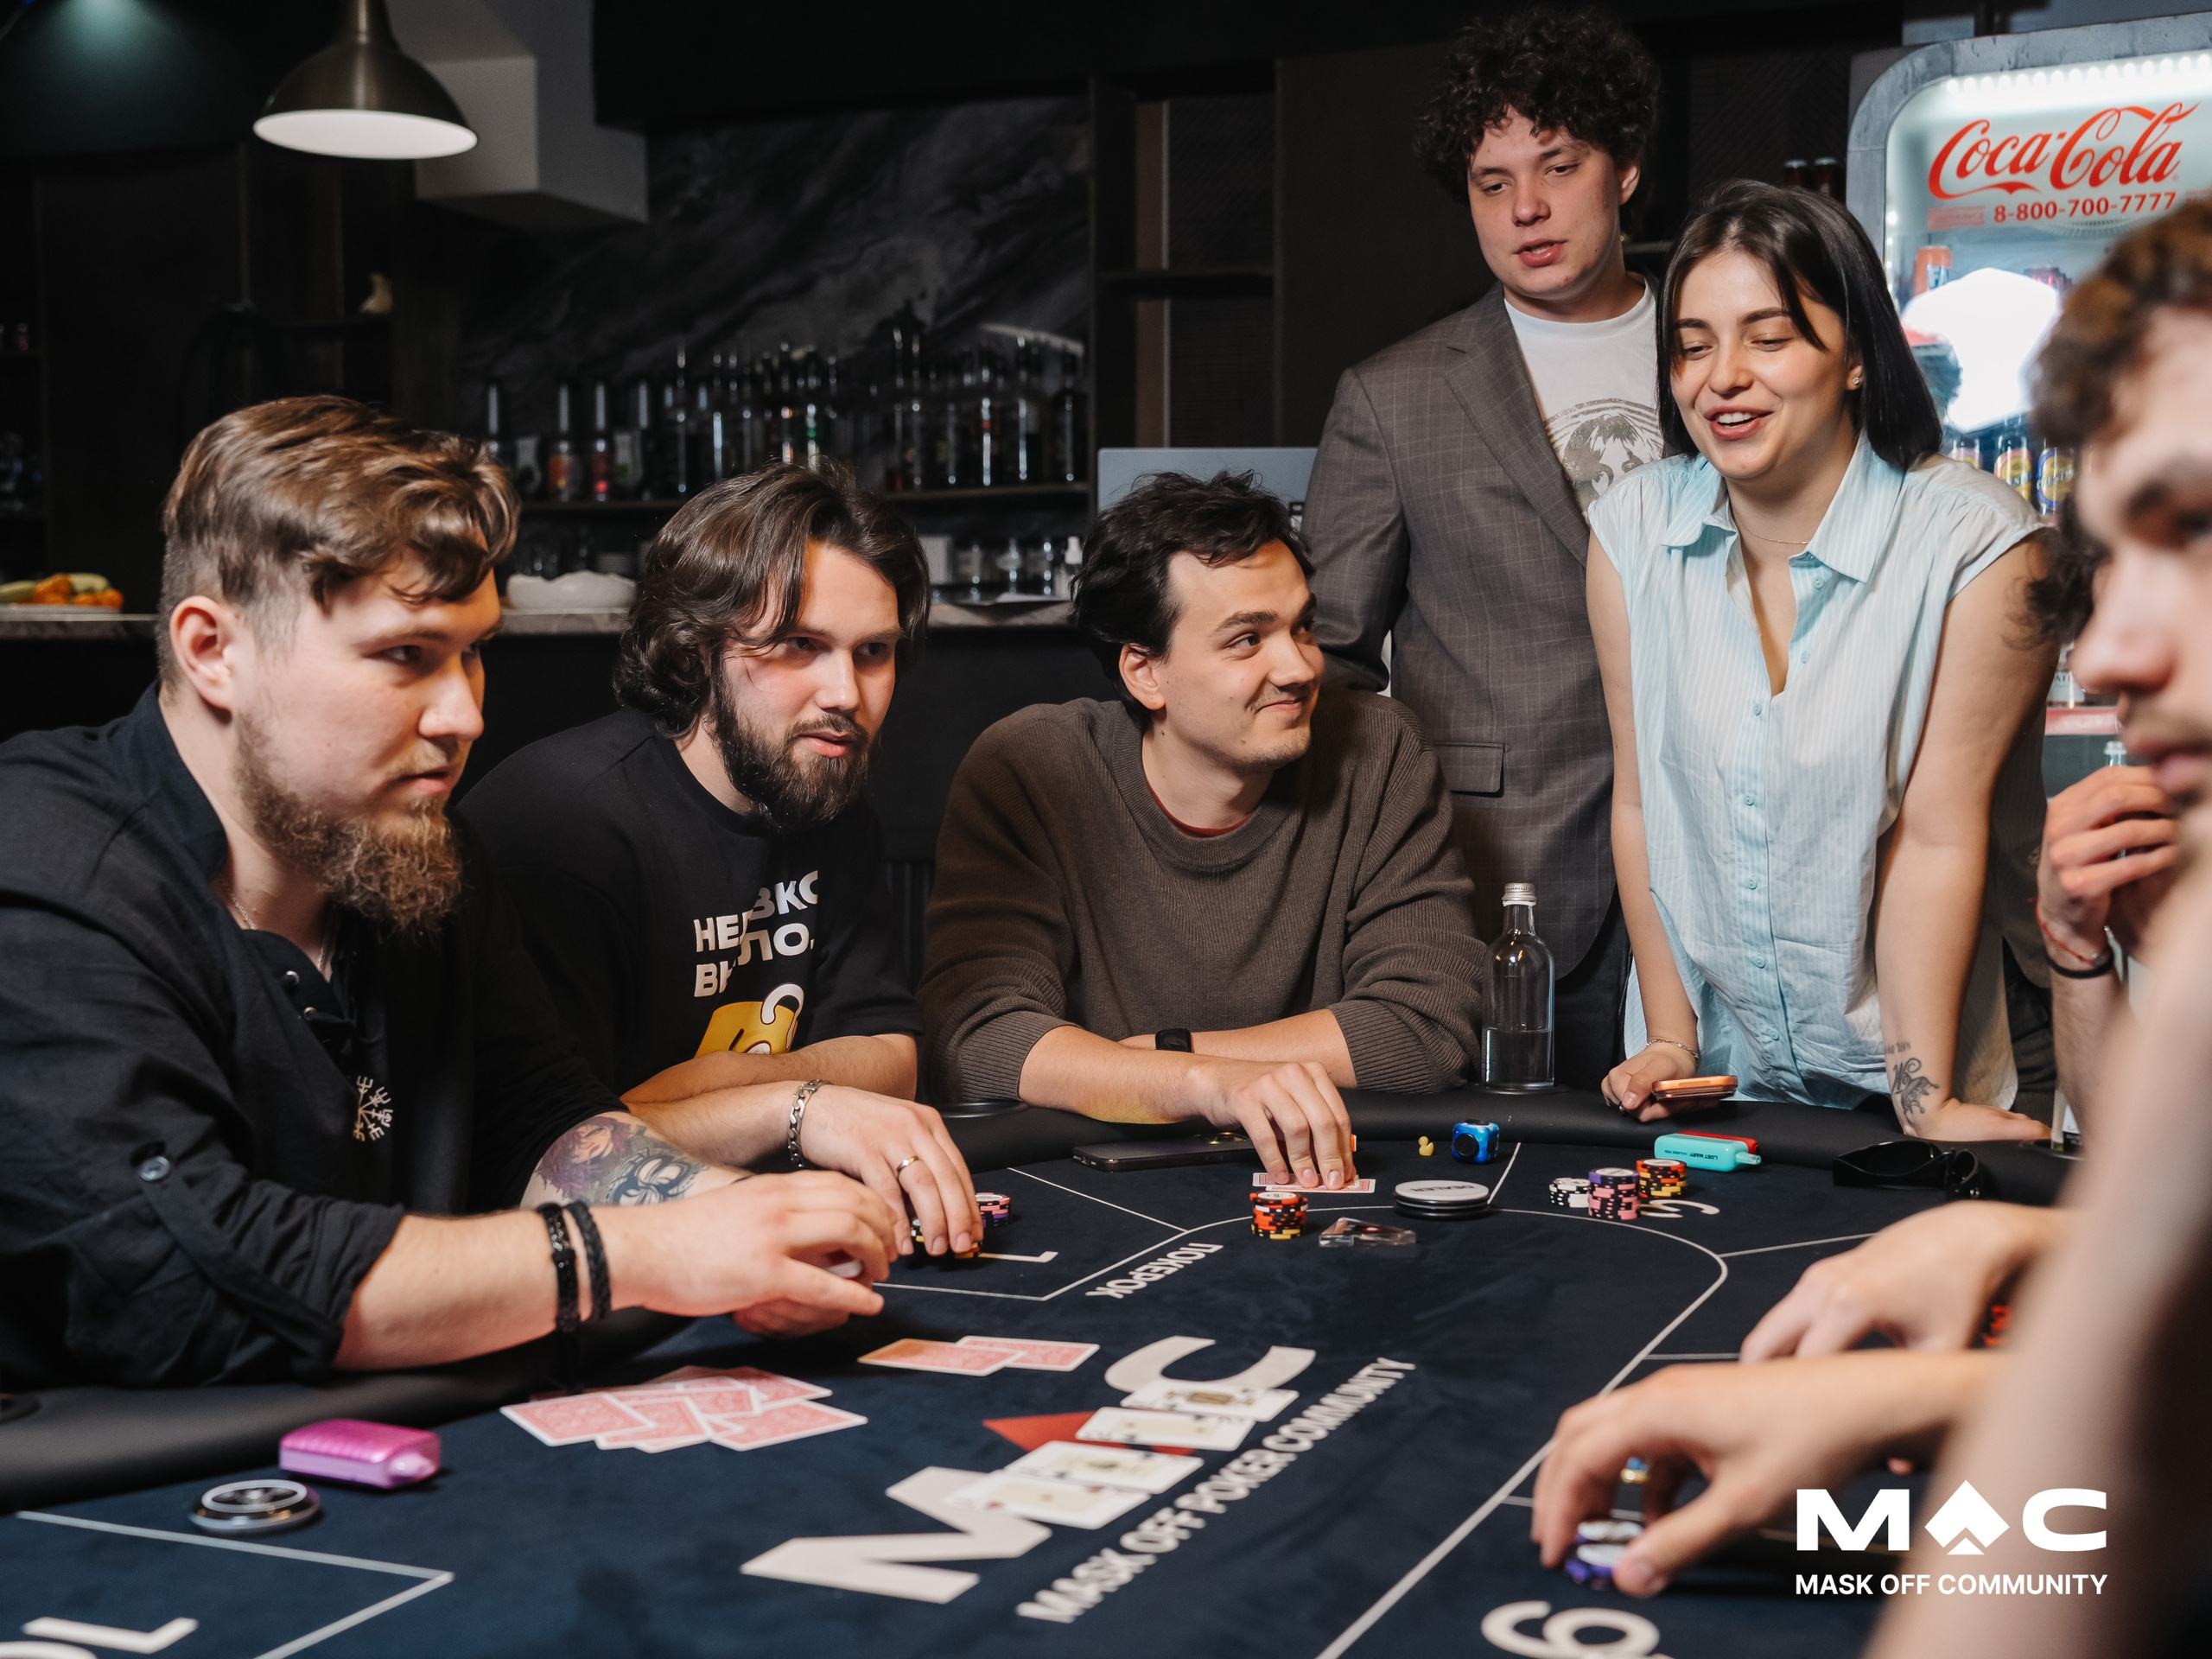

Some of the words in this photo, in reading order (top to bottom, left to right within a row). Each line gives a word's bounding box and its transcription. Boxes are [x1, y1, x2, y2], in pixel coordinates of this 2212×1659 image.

[1928, 100, 2202, 200] Coca-Cola
[1993, 191, 2177, 223] 8-800-700-7777
[1085, 1242, 1224, 1300] ПОКЕРОК
[1015, 1548, 1158, 1624] MASK
[1120, 1507, 1207, 1554] OFF
[1173, 1448, 1297, 1514] POKER
[1262, 1357, 1416, 1453] COMMUNITY
